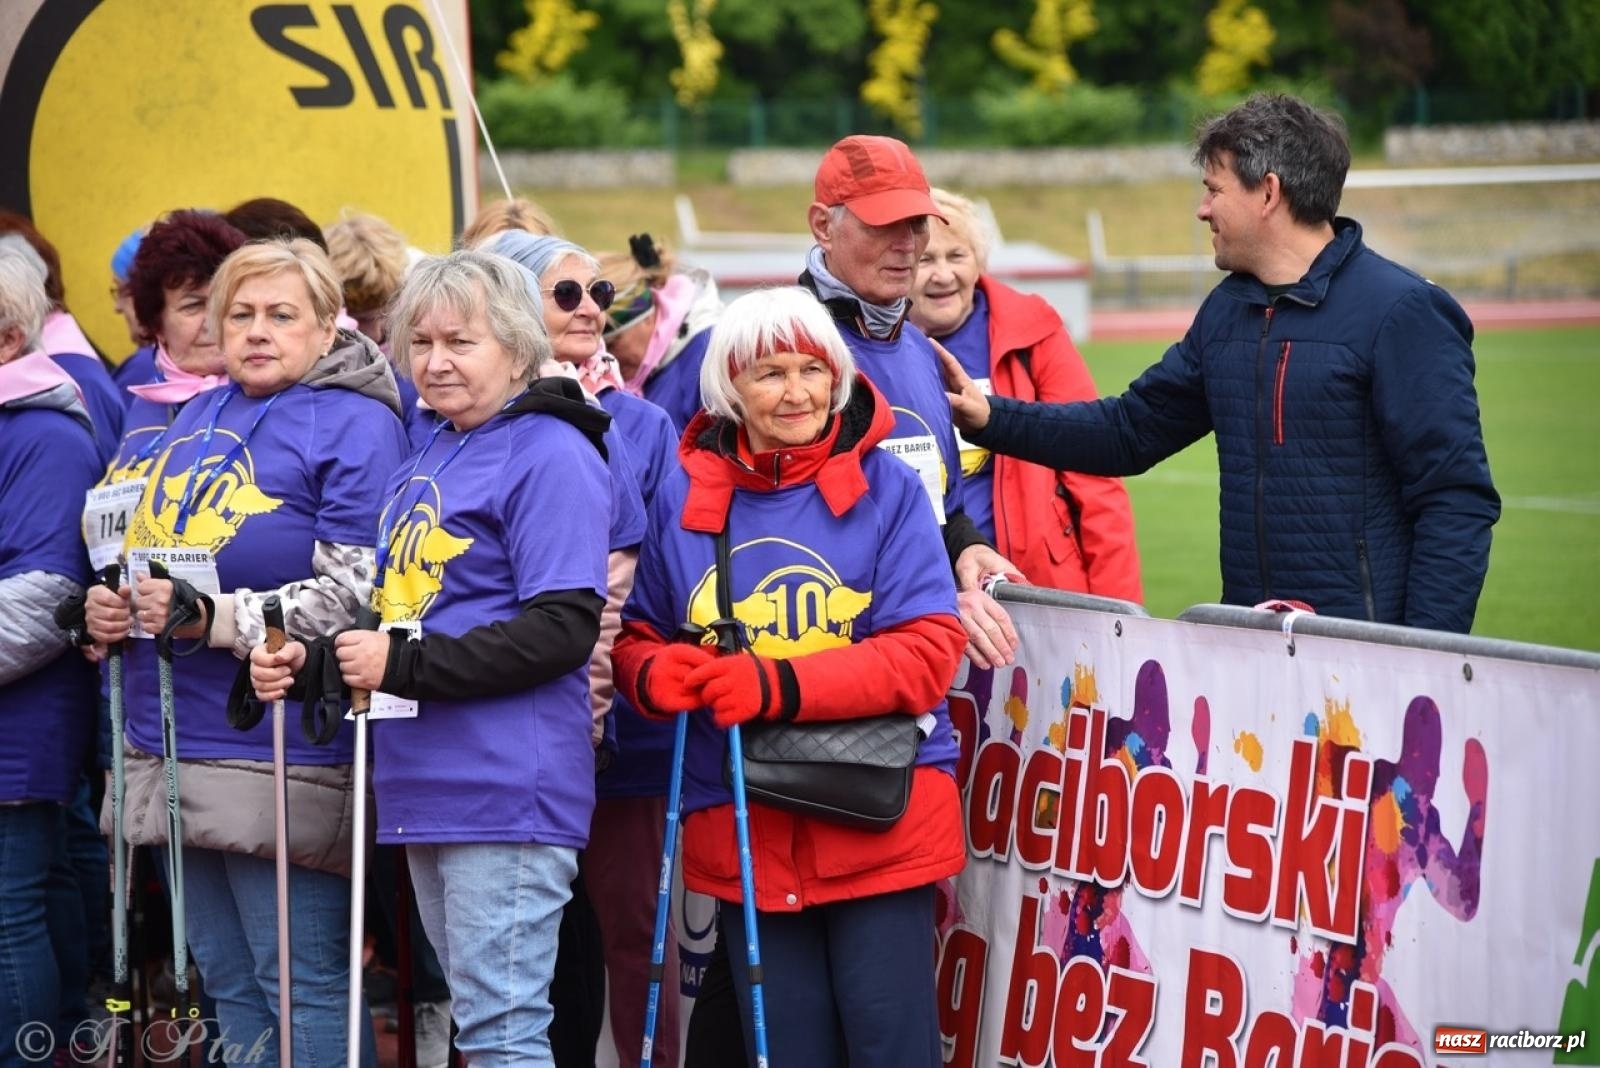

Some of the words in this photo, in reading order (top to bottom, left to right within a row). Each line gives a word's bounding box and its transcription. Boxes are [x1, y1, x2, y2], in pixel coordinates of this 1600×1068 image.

[101, 510, 127, 540] 114
[170, 553, 208, 563] BARIER
[766, 582, 828, 639] 10
[998, 894, 1158, 1068] bez
